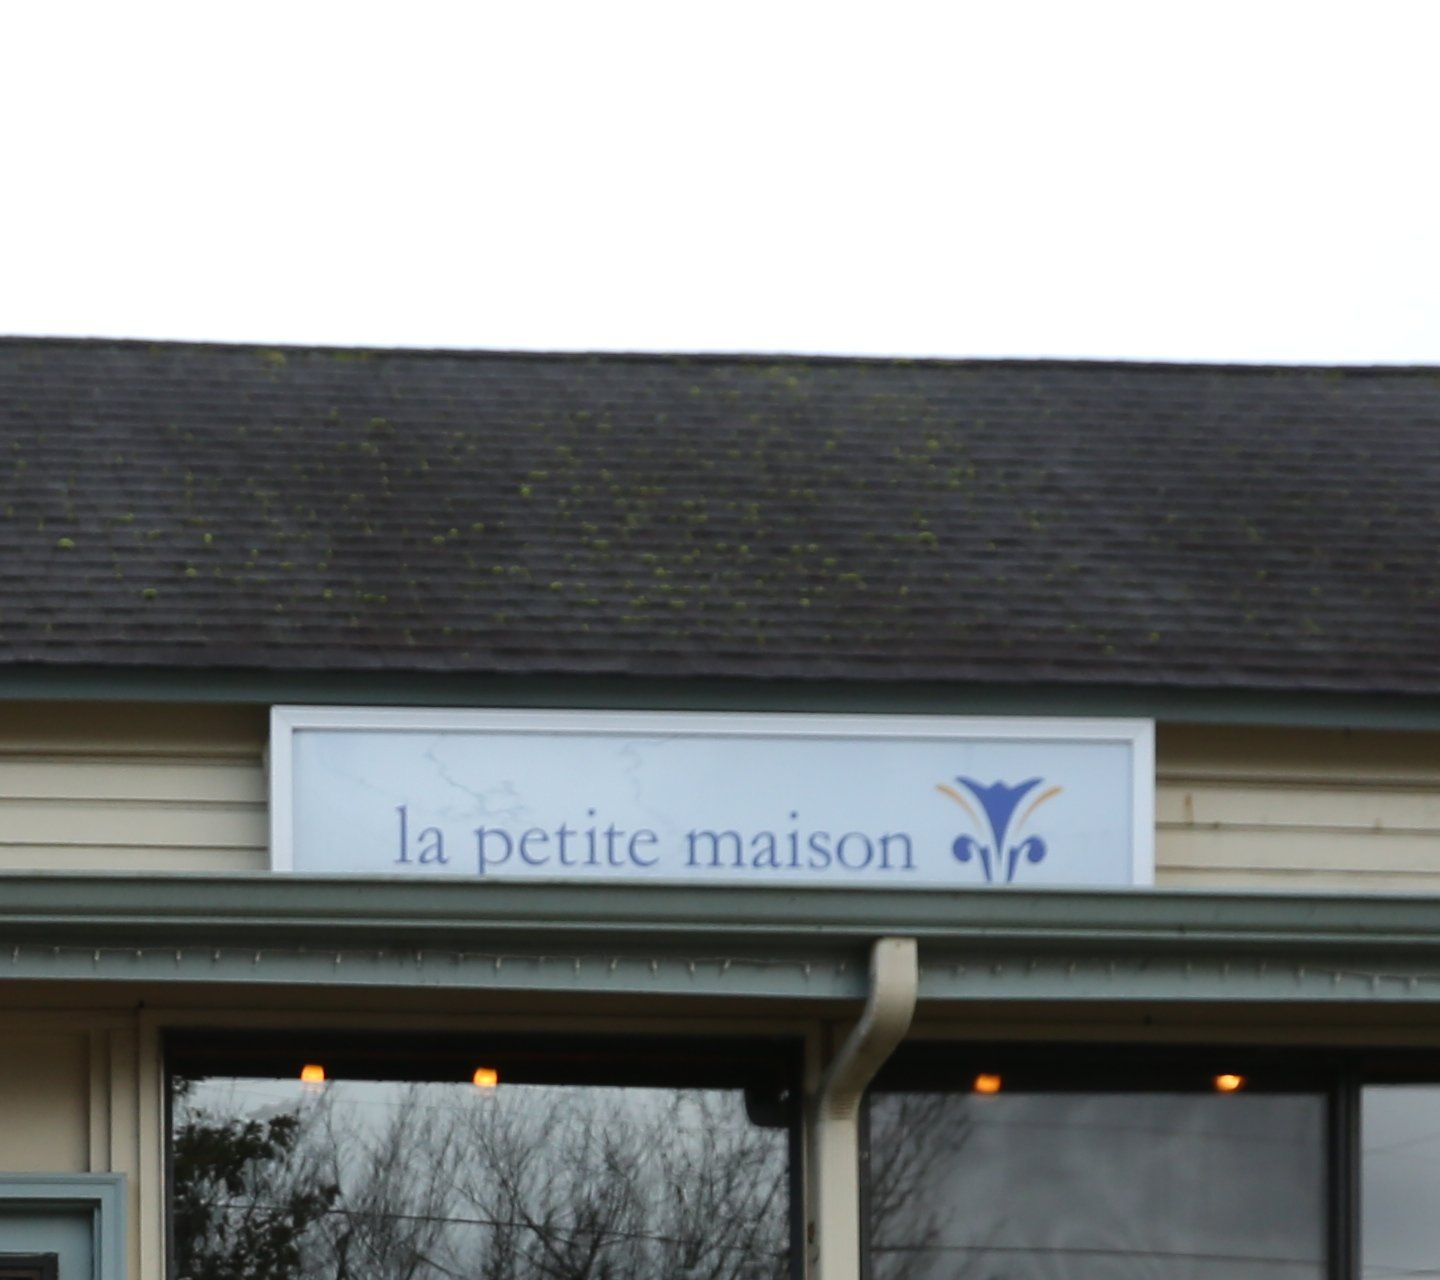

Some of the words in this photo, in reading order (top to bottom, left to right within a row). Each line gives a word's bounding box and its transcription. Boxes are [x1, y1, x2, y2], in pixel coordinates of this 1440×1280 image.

[394, 804, 449, 866] la
[474, 808, 661, 875] petite
[685, 811, 916, 871] maison
